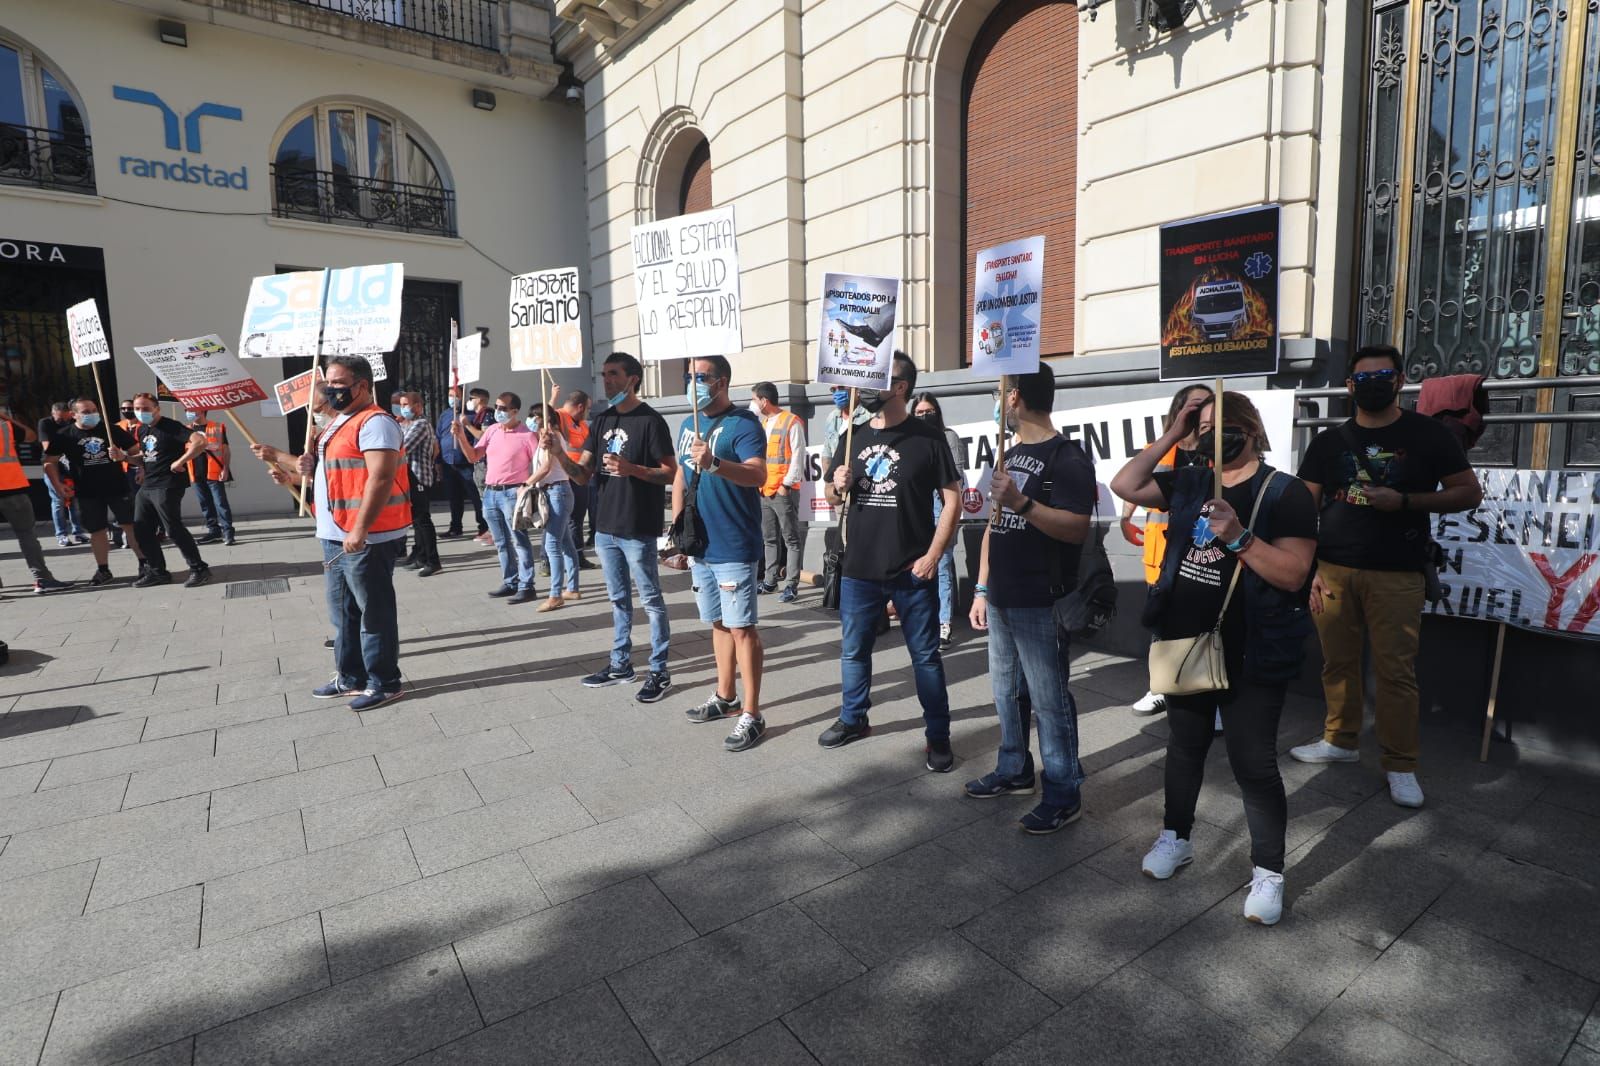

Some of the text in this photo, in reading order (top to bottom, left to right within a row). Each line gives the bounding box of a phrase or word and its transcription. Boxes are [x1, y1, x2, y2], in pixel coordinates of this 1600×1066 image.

[119, 155, 248, 191] randstad
[634, 219, 733, 264] ACCIONA ESTAFA
[1165, 231, 1274, 256] TRANSPORTE SANITARIO
[1194, 251, 1239, 265] EN LUCHA
[638, 258, 726, 300] Y EL SALUD
[872, 294, 886, 303] POR
[887, 295, 896, 303] LA
[995, 295, 1018, 308] CONVENIO
[642, 293, 738, 335] LO RESPALDA
[278, 368, 321, 396] SE VENE
[841, 369, 865, 378] CONVENIO
[180, 389, 253, 409] EN HUELGA
[1186, 546, 1225, 564] LUCHA
